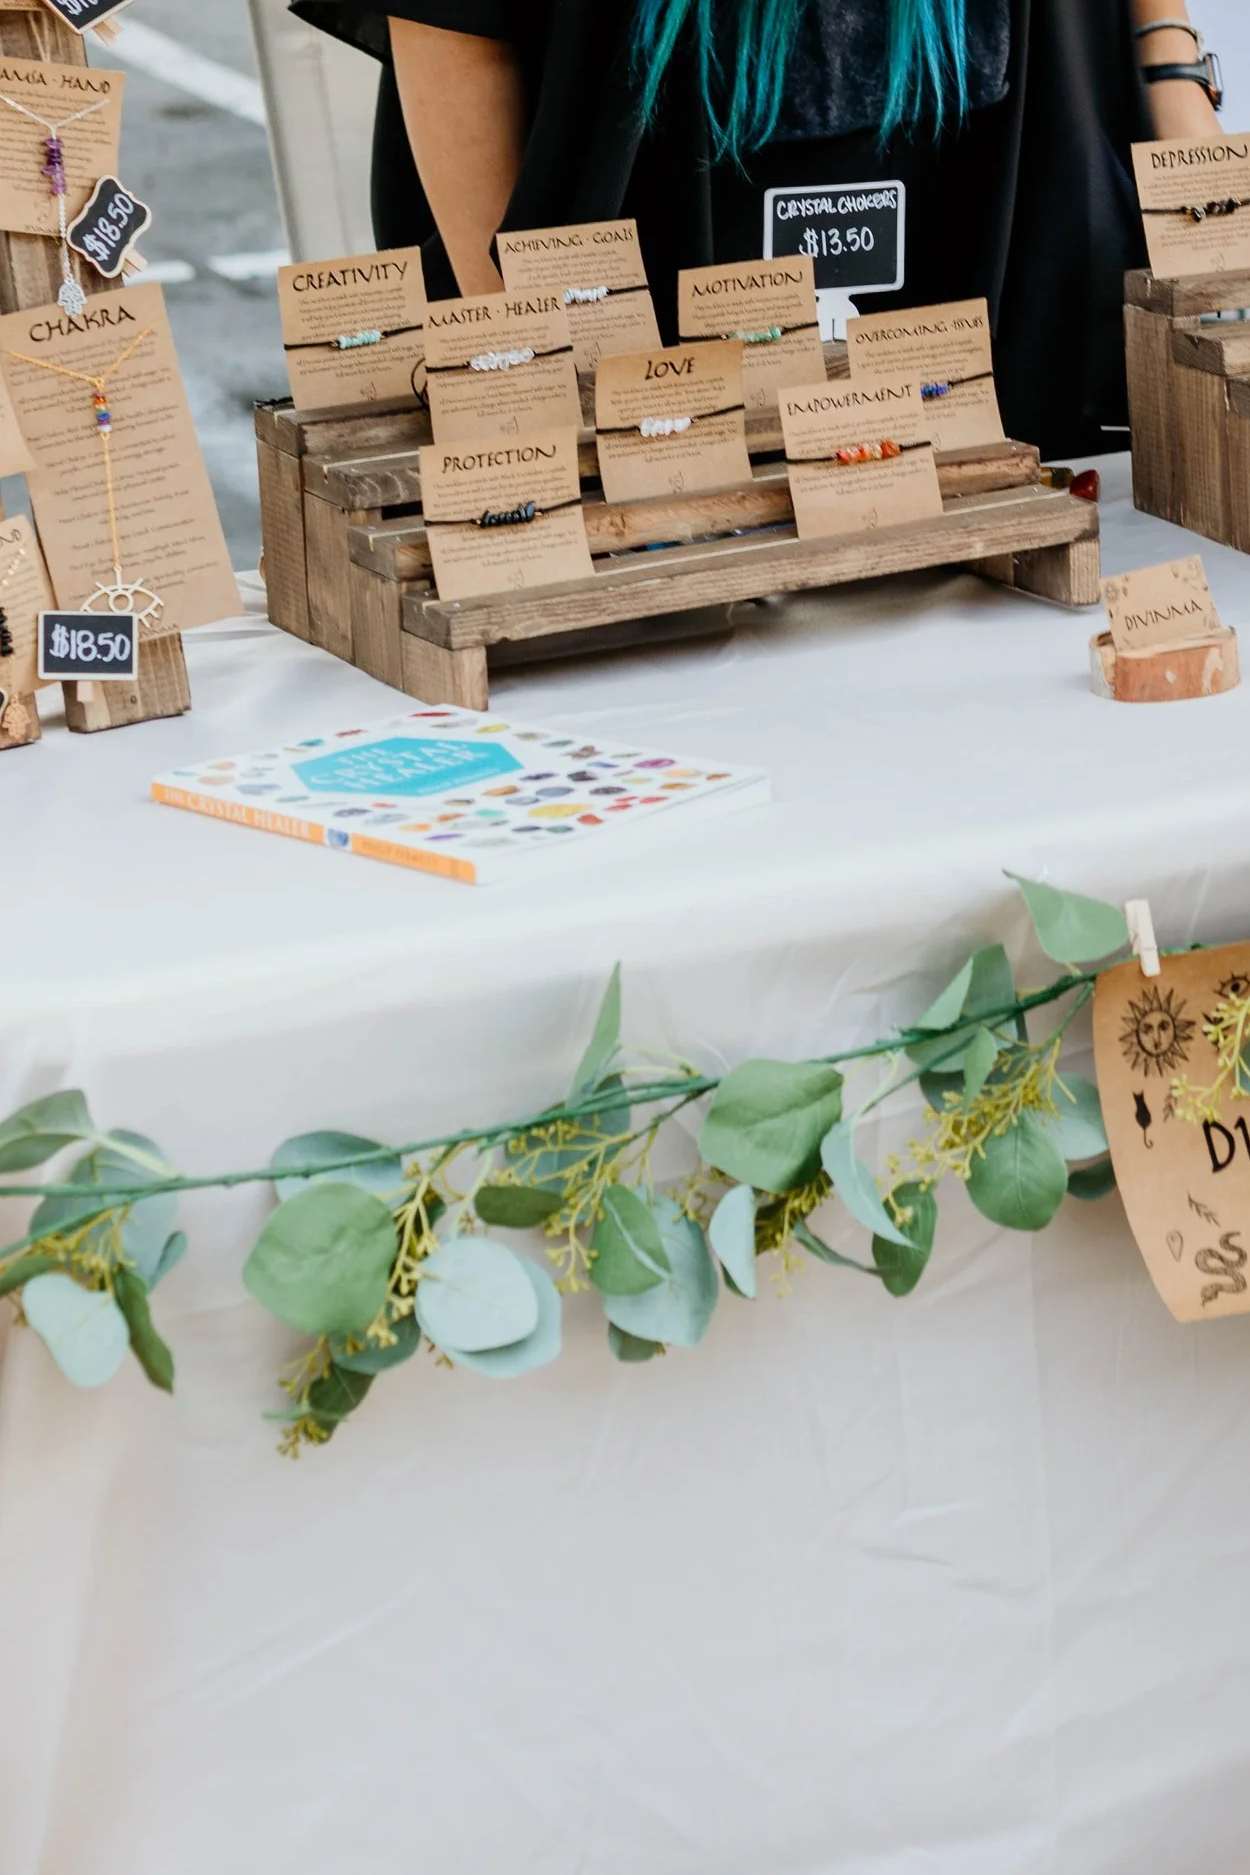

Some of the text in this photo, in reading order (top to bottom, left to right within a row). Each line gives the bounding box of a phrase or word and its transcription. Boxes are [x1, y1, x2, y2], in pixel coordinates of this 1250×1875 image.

[61, 75, 111, 94] HAND
[1151, 143, 1249, 170] DEPRESSION
[776, 190, 898, 221] CRYSTAL CHOKERS
[82, 193, 135, 262] $18.50
[504, 228, 635, 254] ACHIEVING GOALS
[798, 226, 875, 258] $13.50
[292, 261, 408, 293] CREATIVITY
[691, 270, 803, 298] MOTIVATION
[29, 306, 136, 343] CHAKRA
[428, 305, 492, 329] MASTER
[504, 296, 561, 319] HEALER
[855, 321, 948, 345] OVERCOMING
[644, 356, 696, 381] LOVE
[786, 384, 915, 418] EMPOWERMENT
[442, 444, 557, 474] PROTECTION
[1124, 599, 1204, 632] DIVINMA
[50, 623, 131, 662] $18.50
